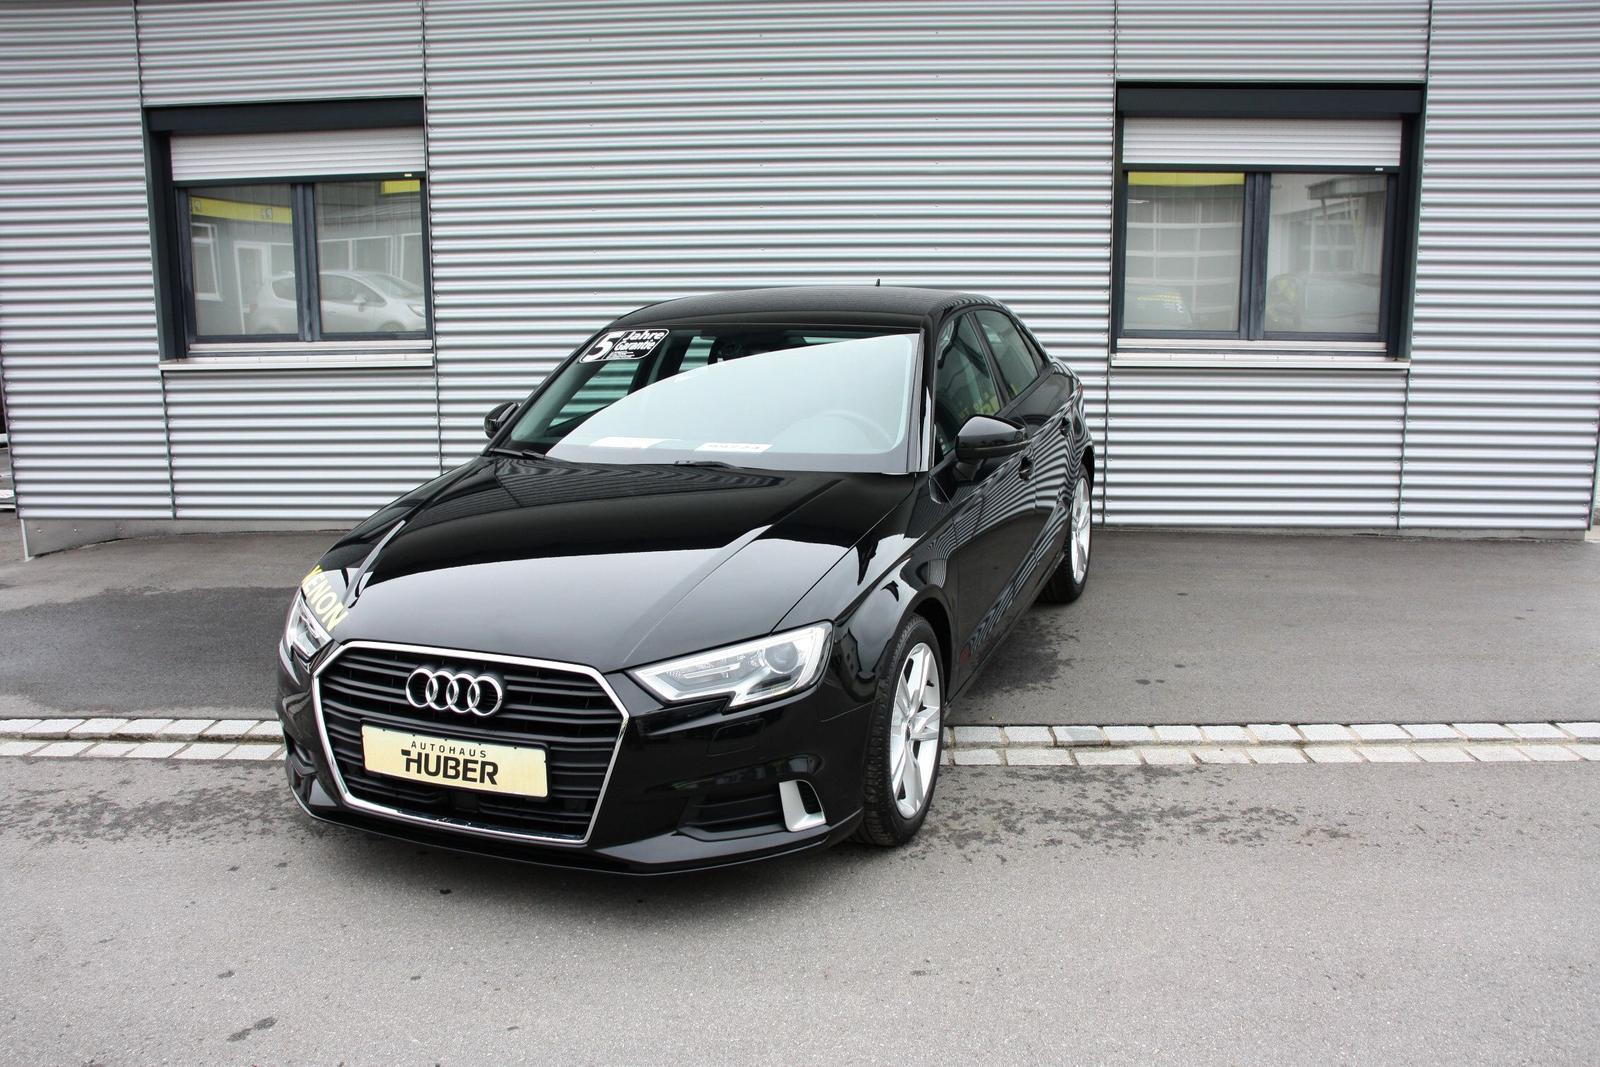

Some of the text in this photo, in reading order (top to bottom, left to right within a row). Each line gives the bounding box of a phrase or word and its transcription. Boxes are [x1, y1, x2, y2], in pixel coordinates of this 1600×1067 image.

[583, 330, 665, 361] 5 Jahre
[411, 740, 487, 758] AUTOHAUS
[401, 749, 499, 785] HUBER
